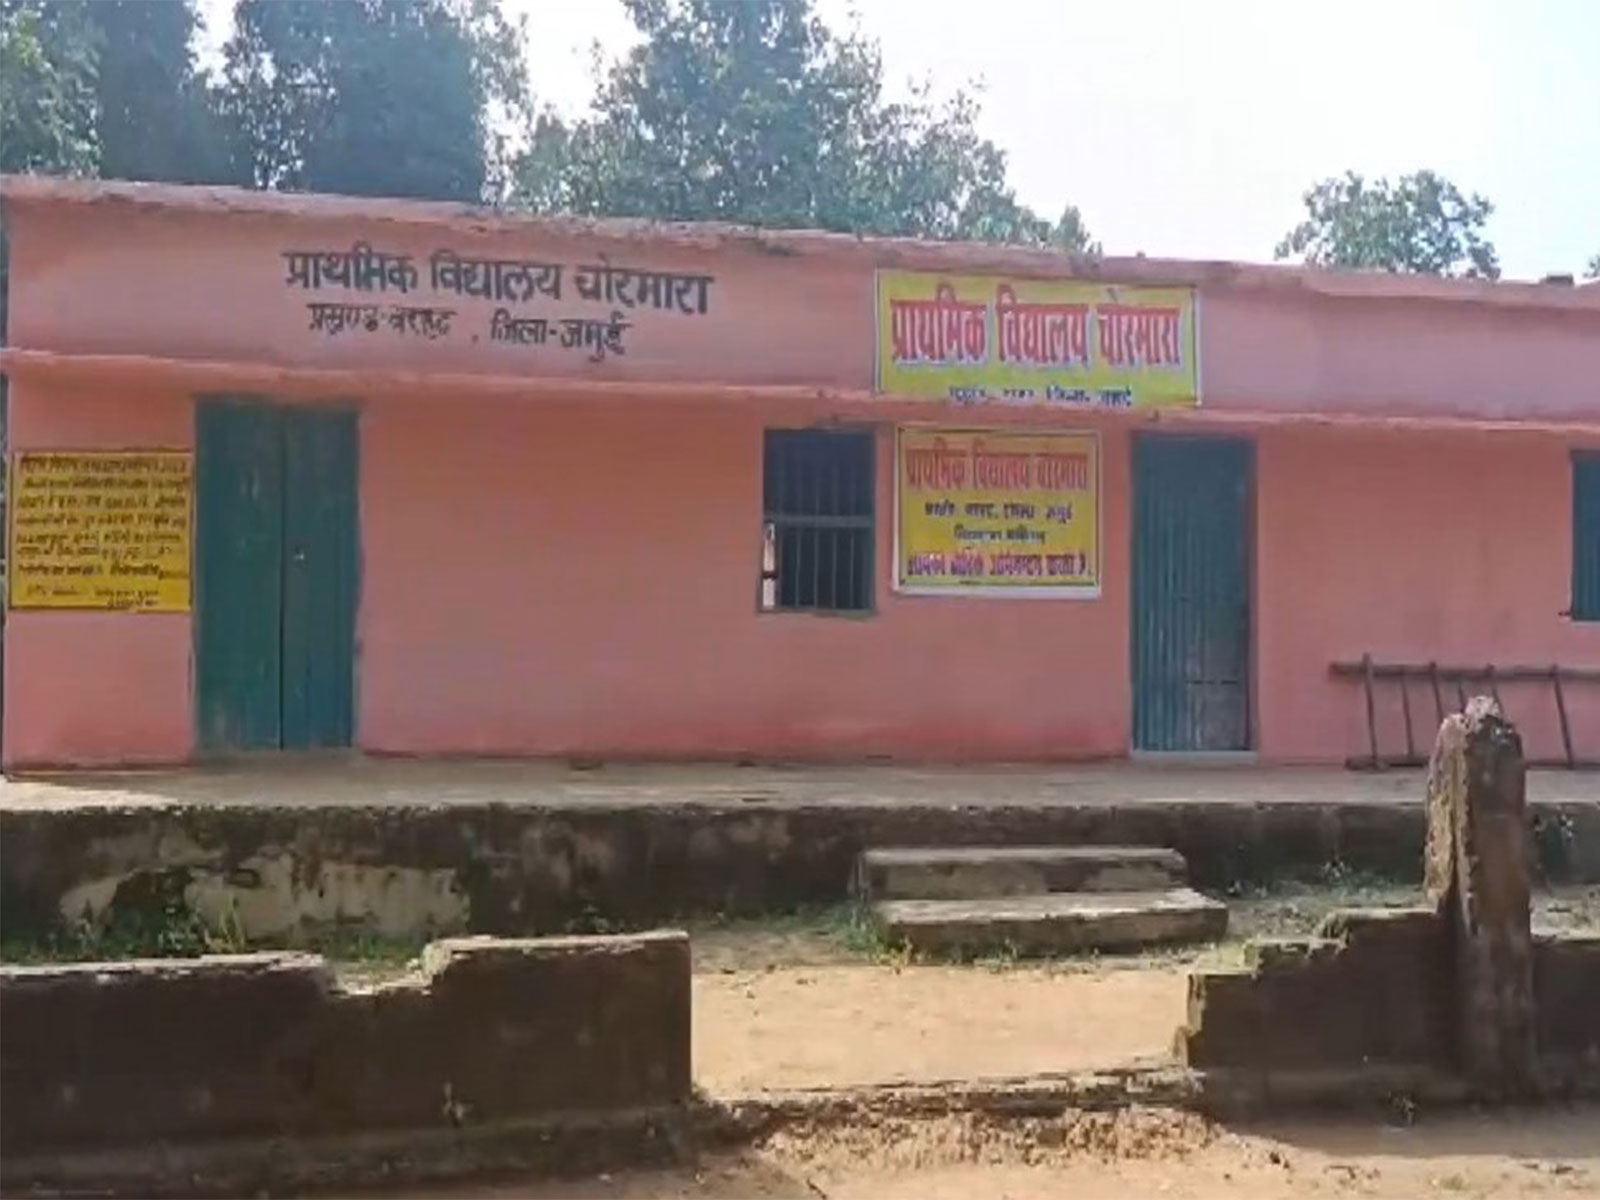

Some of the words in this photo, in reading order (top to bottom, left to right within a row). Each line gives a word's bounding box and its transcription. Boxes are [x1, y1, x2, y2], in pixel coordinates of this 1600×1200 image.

[283, 242, 418, 294] प्राथमिक
[430, 251, 566, 303] विद्यालय
[574, 254, 716, 315] चोरमारा
[890, 282, 986, 362] प्राथमिक
[996, 283, 1089, 366] विद्यालय
[1097, 287, 1181, 366] चोरमारा
[906, 436, 966, 490] प्राथमिक
[973, 437, 1030, 490] विद्यालय
[1036, 442, 1088, 489] चोरमारा
